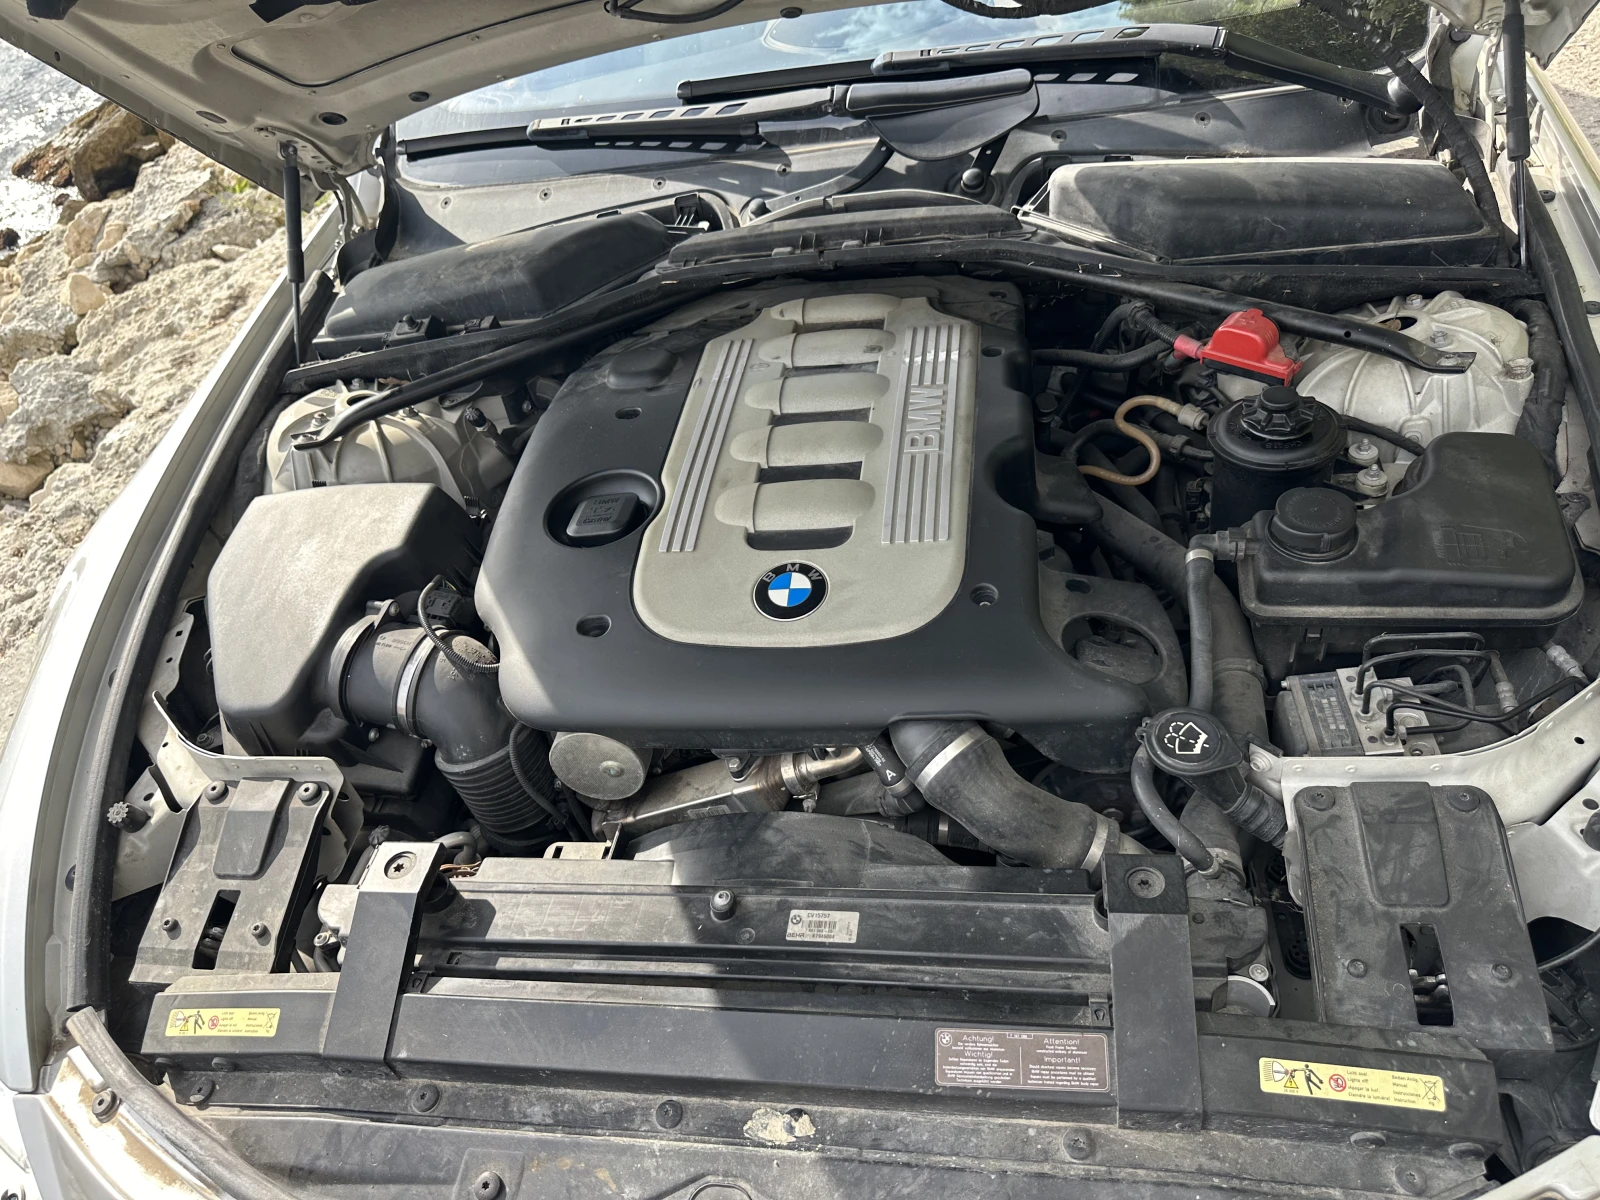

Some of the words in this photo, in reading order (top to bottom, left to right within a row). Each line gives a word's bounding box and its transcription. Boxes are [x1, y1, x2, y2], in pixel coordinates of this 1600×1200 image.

[904, 387, 944, 453] BMW
[762, 564, 823, 583] BMW
[886, 769, 897, 781] A
[962, 1034, 995, 1043] Achtung!
[1043, 1038, 1080, 1046] Attention!
[964, 1050, 994, 1058] Wichtig!
[1043, 1055, 1081, 1064] Important!
